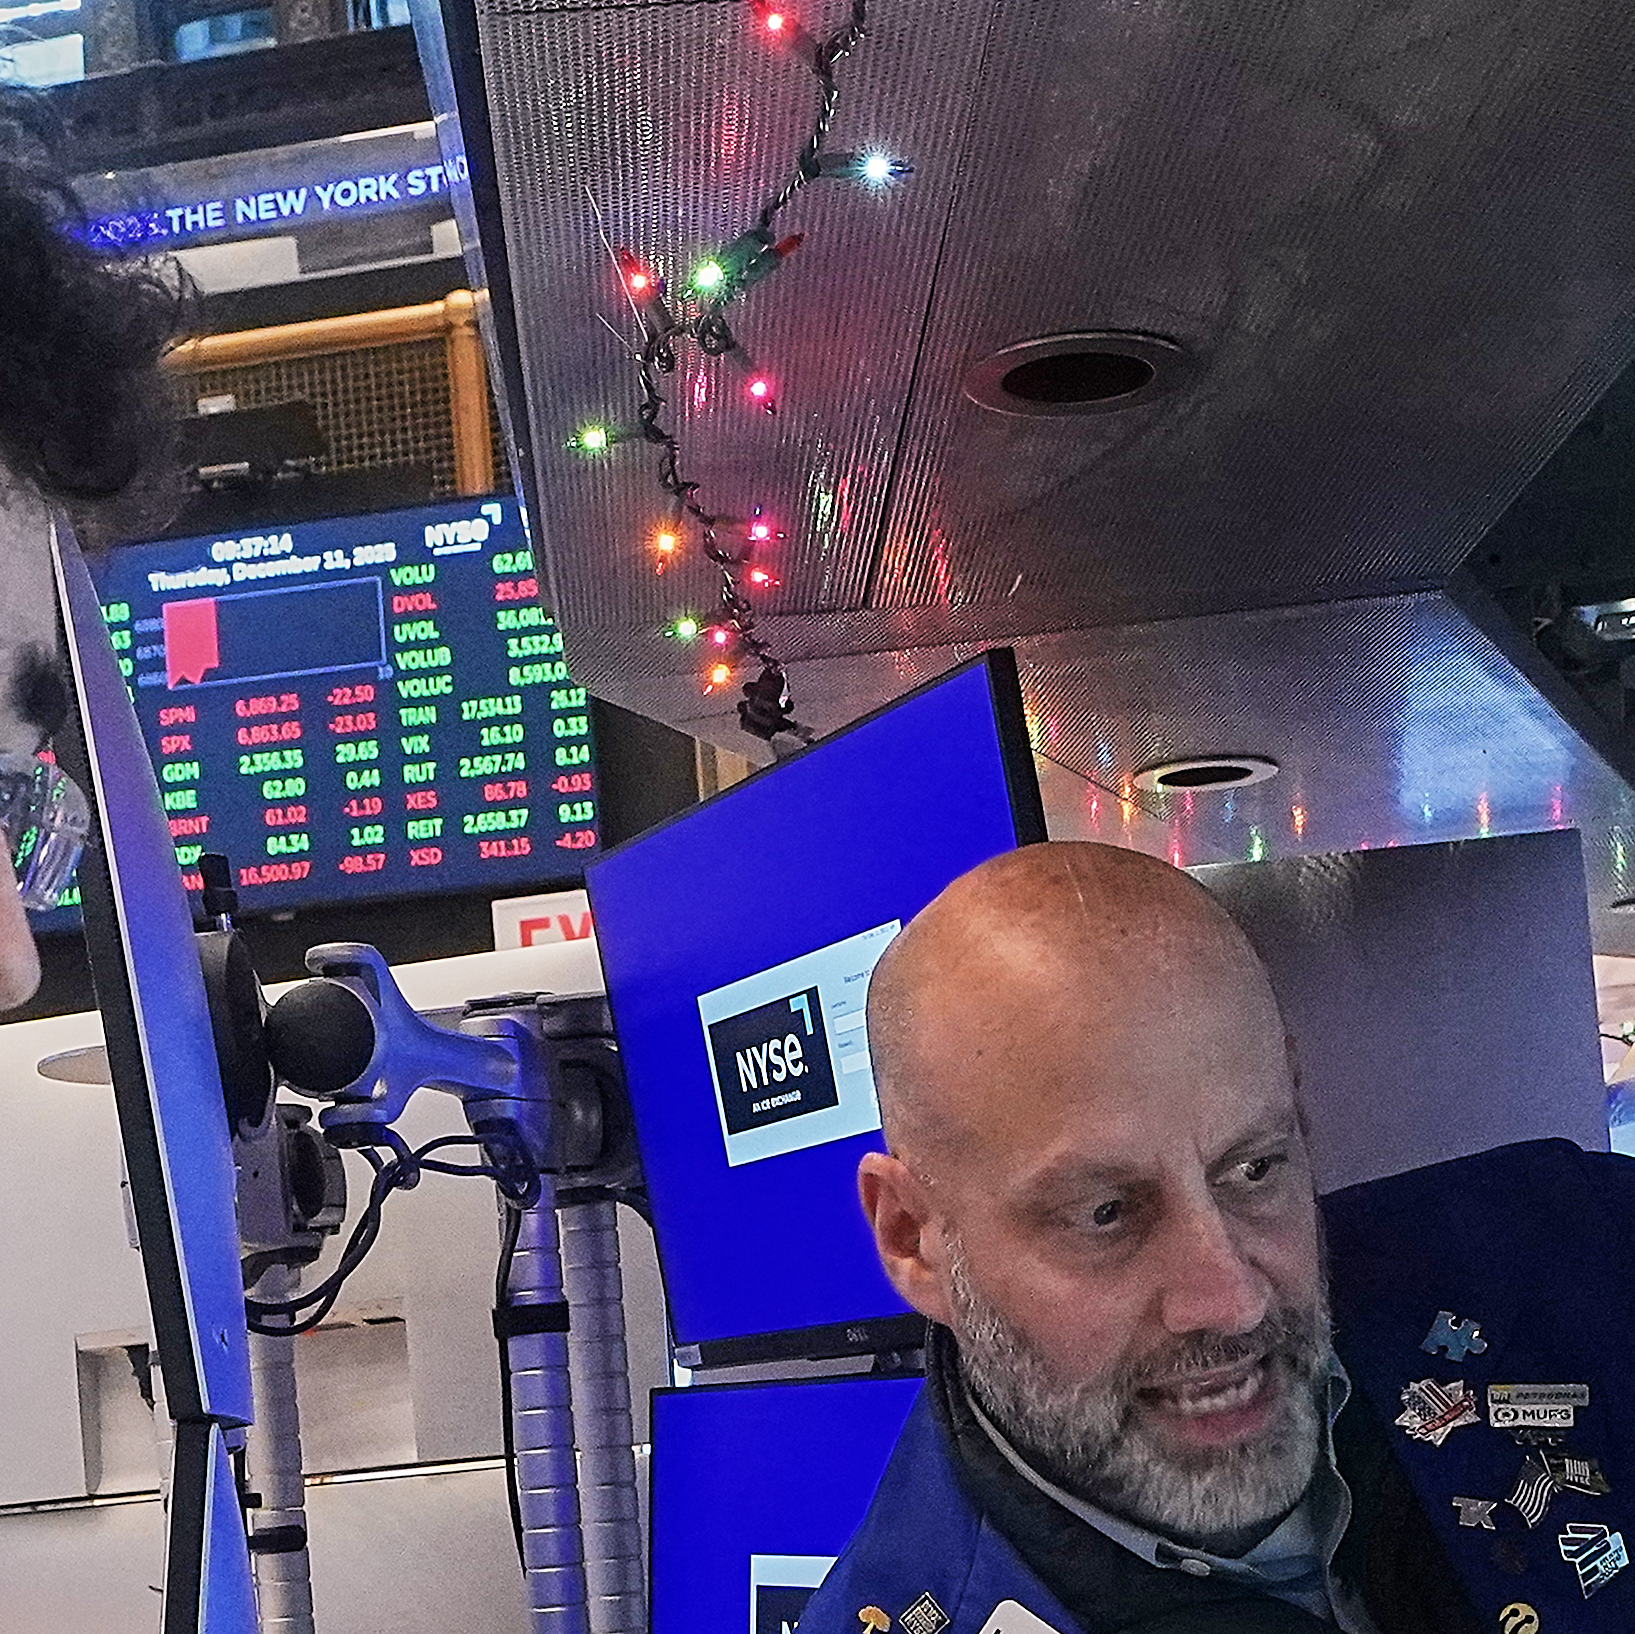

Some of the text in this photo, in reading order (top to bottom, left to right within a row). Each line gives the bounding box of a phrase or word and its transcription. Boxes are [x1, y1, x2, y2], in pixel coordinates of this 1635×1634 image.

[166, 173, 400, 235] THE NEW YORK
[148, 563, 230, 592] Thursday,
[232, 555, 321, 582] December
[353, 543, 397, 567] 2025
[390, 564, 436, 586] VOLU
[392, 592, 438, 614] DVOL
[393, 620, 439, 642] UVOL
[397, 674, 453, 699] VOLUC
[399, 704, 437, 727] TRAN
[160, 733, 192, 755] SPX
[401, 733, 430, 755] VIX
[162, 761, 200, 784] GDM
[345, 769, 381, 791] 0.44
[403, 761, 437, 784] RUT
[406, 790, 438, 811] XES
[407, 817, 443, 841] REIT
[558, 800, 594, 823] 9.13
[350, 825, 385, 848] 1.02
[409, 846, 442, 867] XSD
[554, 829, 596, 851] -4.20
[1522, 1408, 1571, 1421] MUFG
